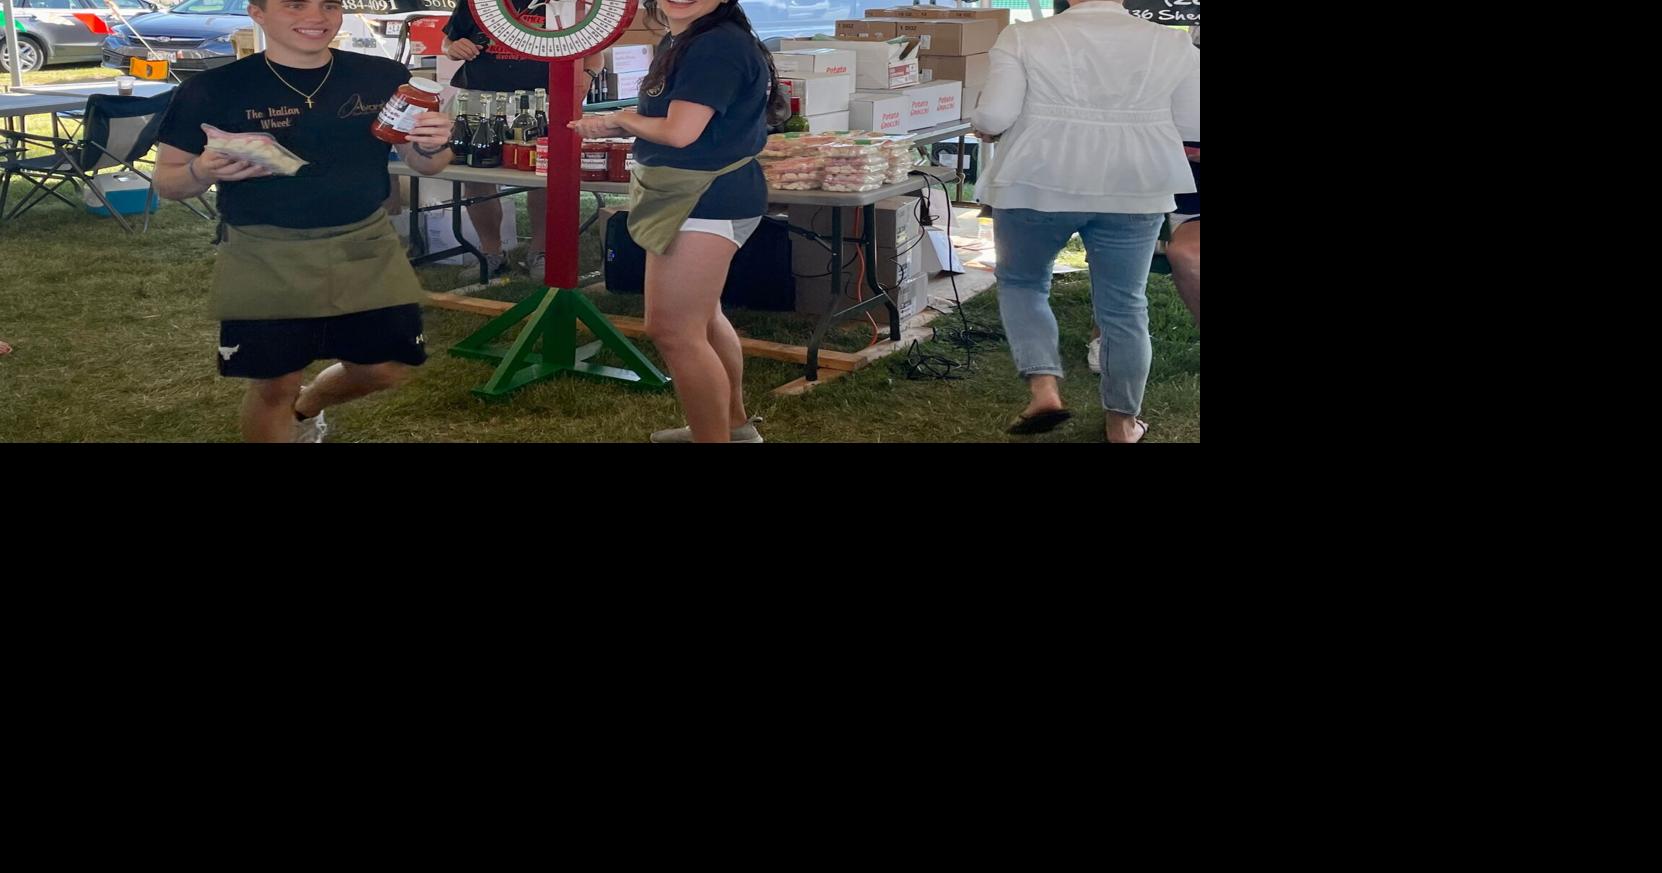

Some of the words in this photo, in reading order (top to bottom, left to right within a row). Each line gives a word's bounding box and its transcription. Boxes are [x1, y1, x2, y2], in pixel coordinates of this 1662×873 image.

[1158, 9, 1200, 20] She
[246, 109, 264, 120] The
[268, 105, 301, 117] Italian
[260, 118, 291, 130] Wheel
